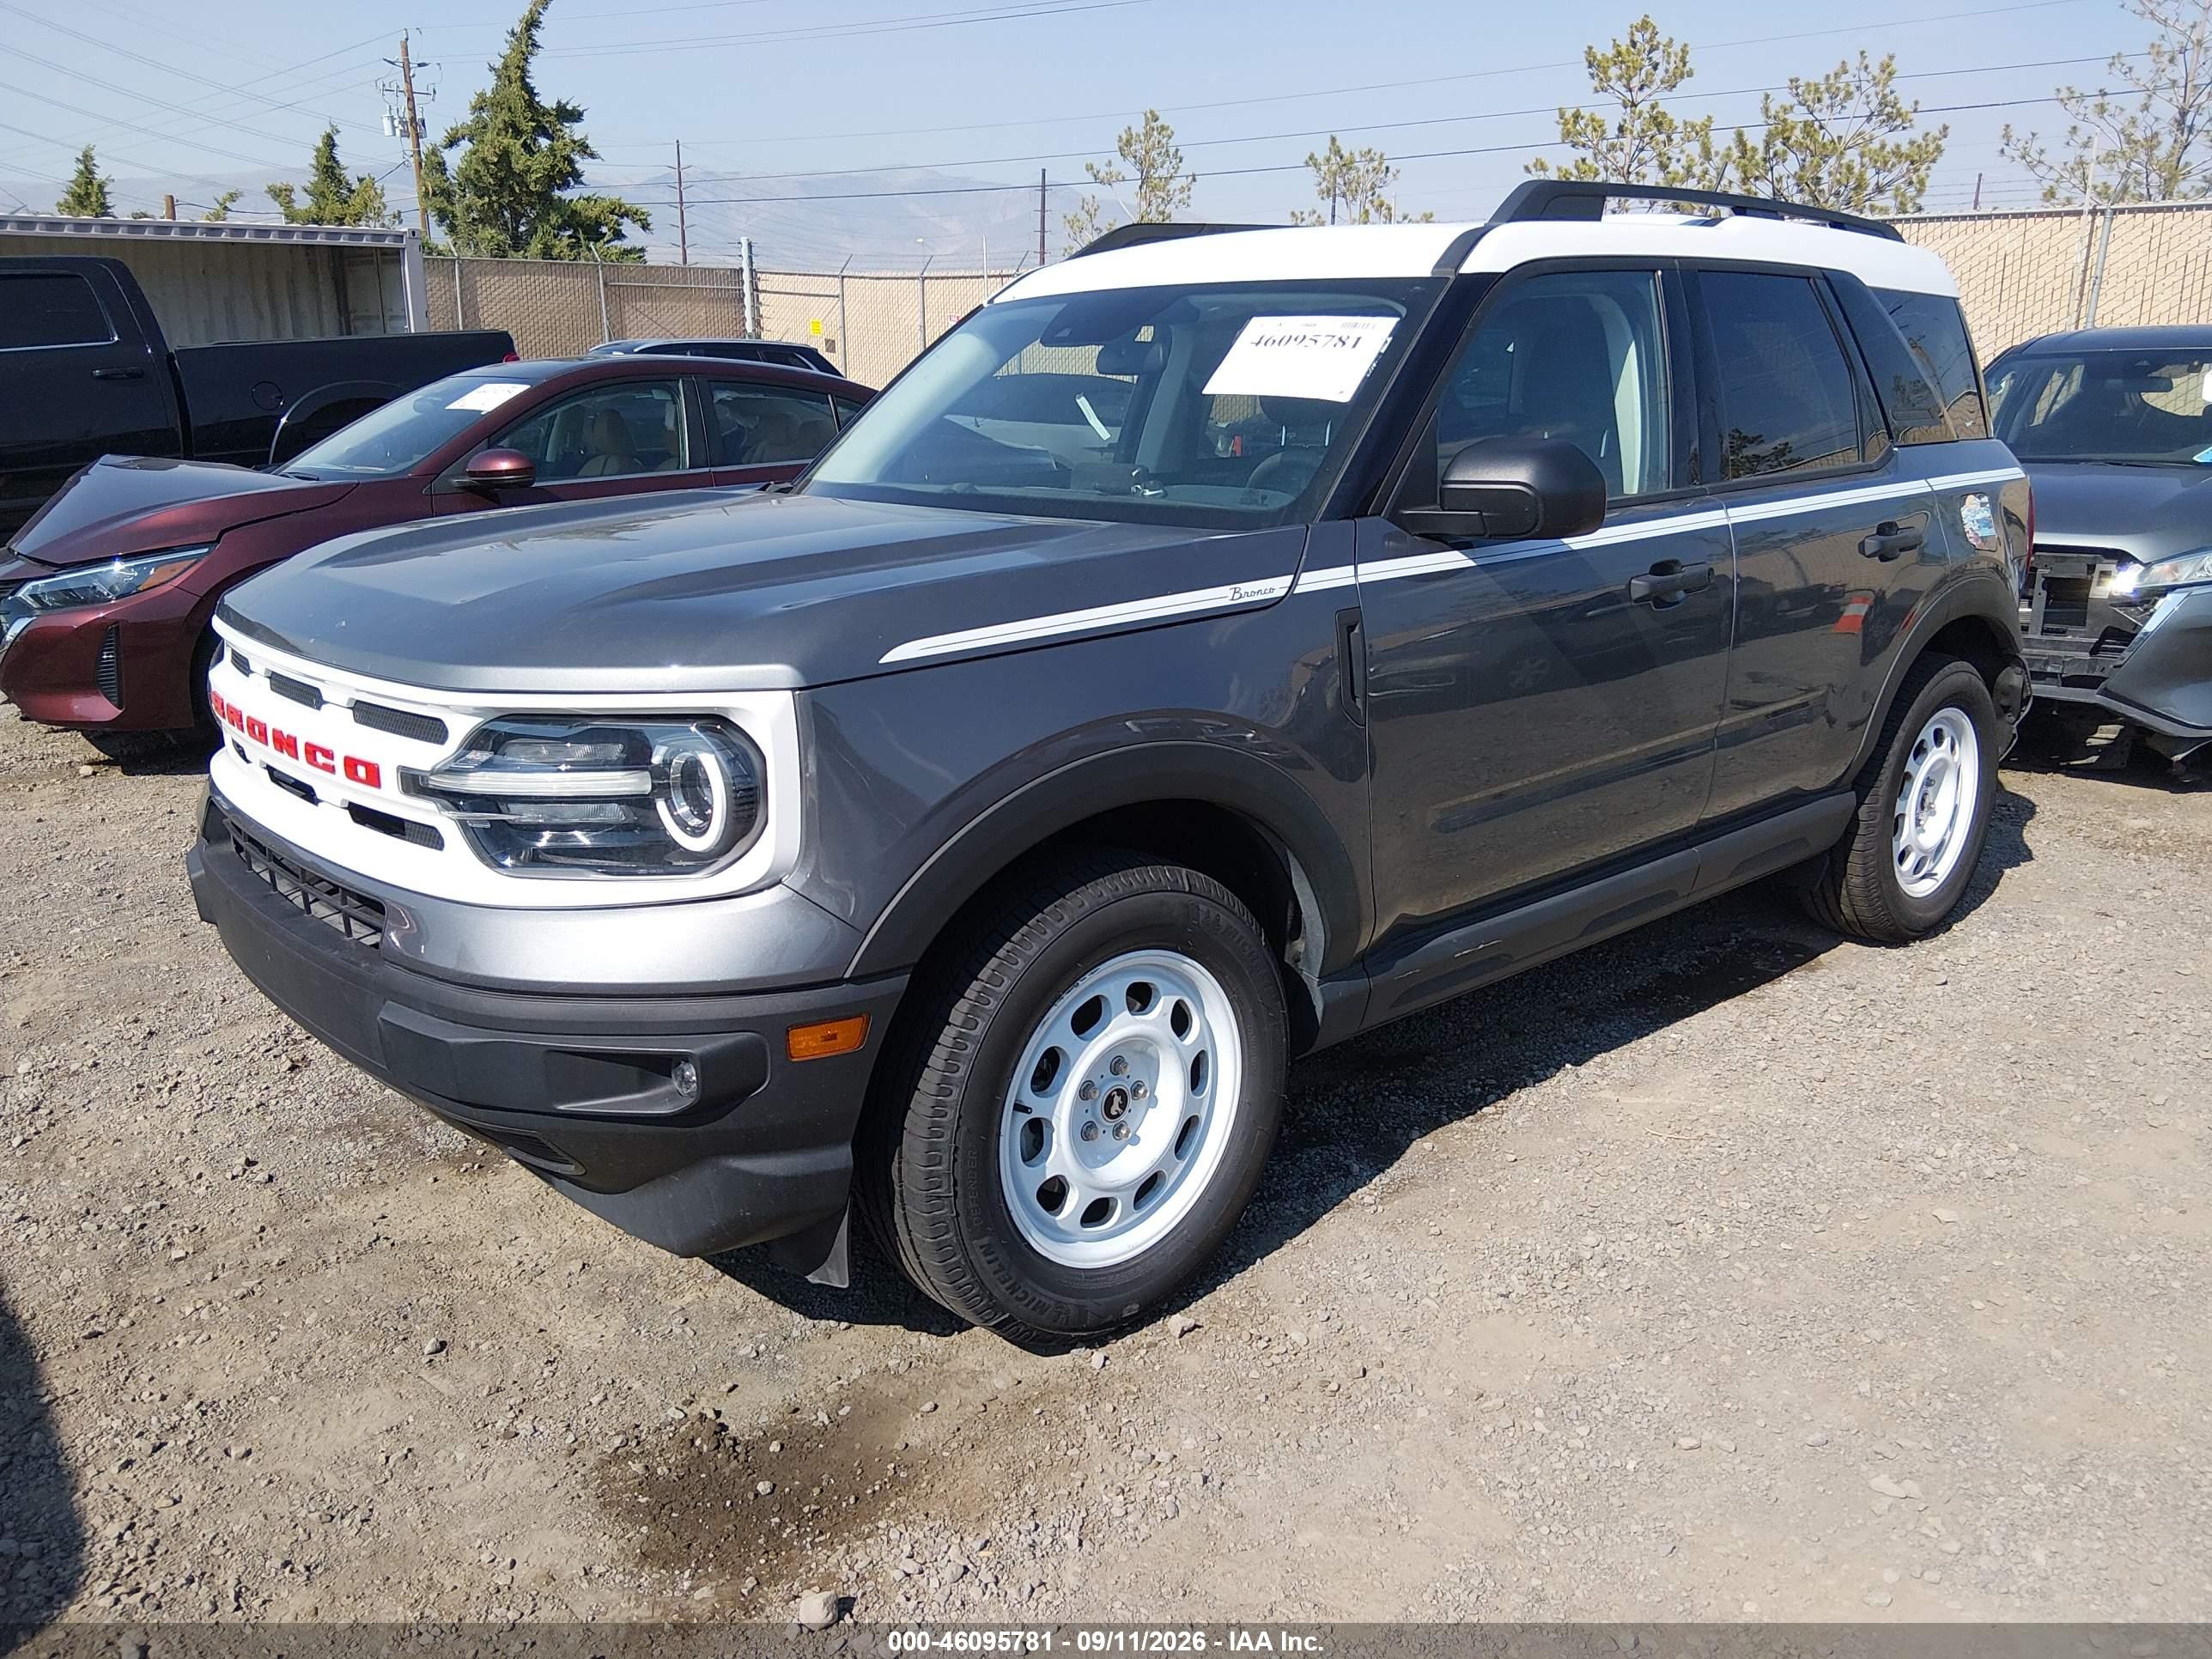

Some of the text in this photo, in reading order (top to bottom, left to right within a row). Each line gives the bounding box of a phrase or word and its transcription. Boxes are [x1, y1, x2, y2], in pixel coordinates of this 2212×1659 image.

[1250, 334, 1363, 349] 46095781
[1229, 587, 1276, 600] Bronco
[210, 690, 382, 790] BRONCO
[967, 1149, 983, 1226] DEFENDER
[980, 1241, 1052, 1314] MICHELIN
